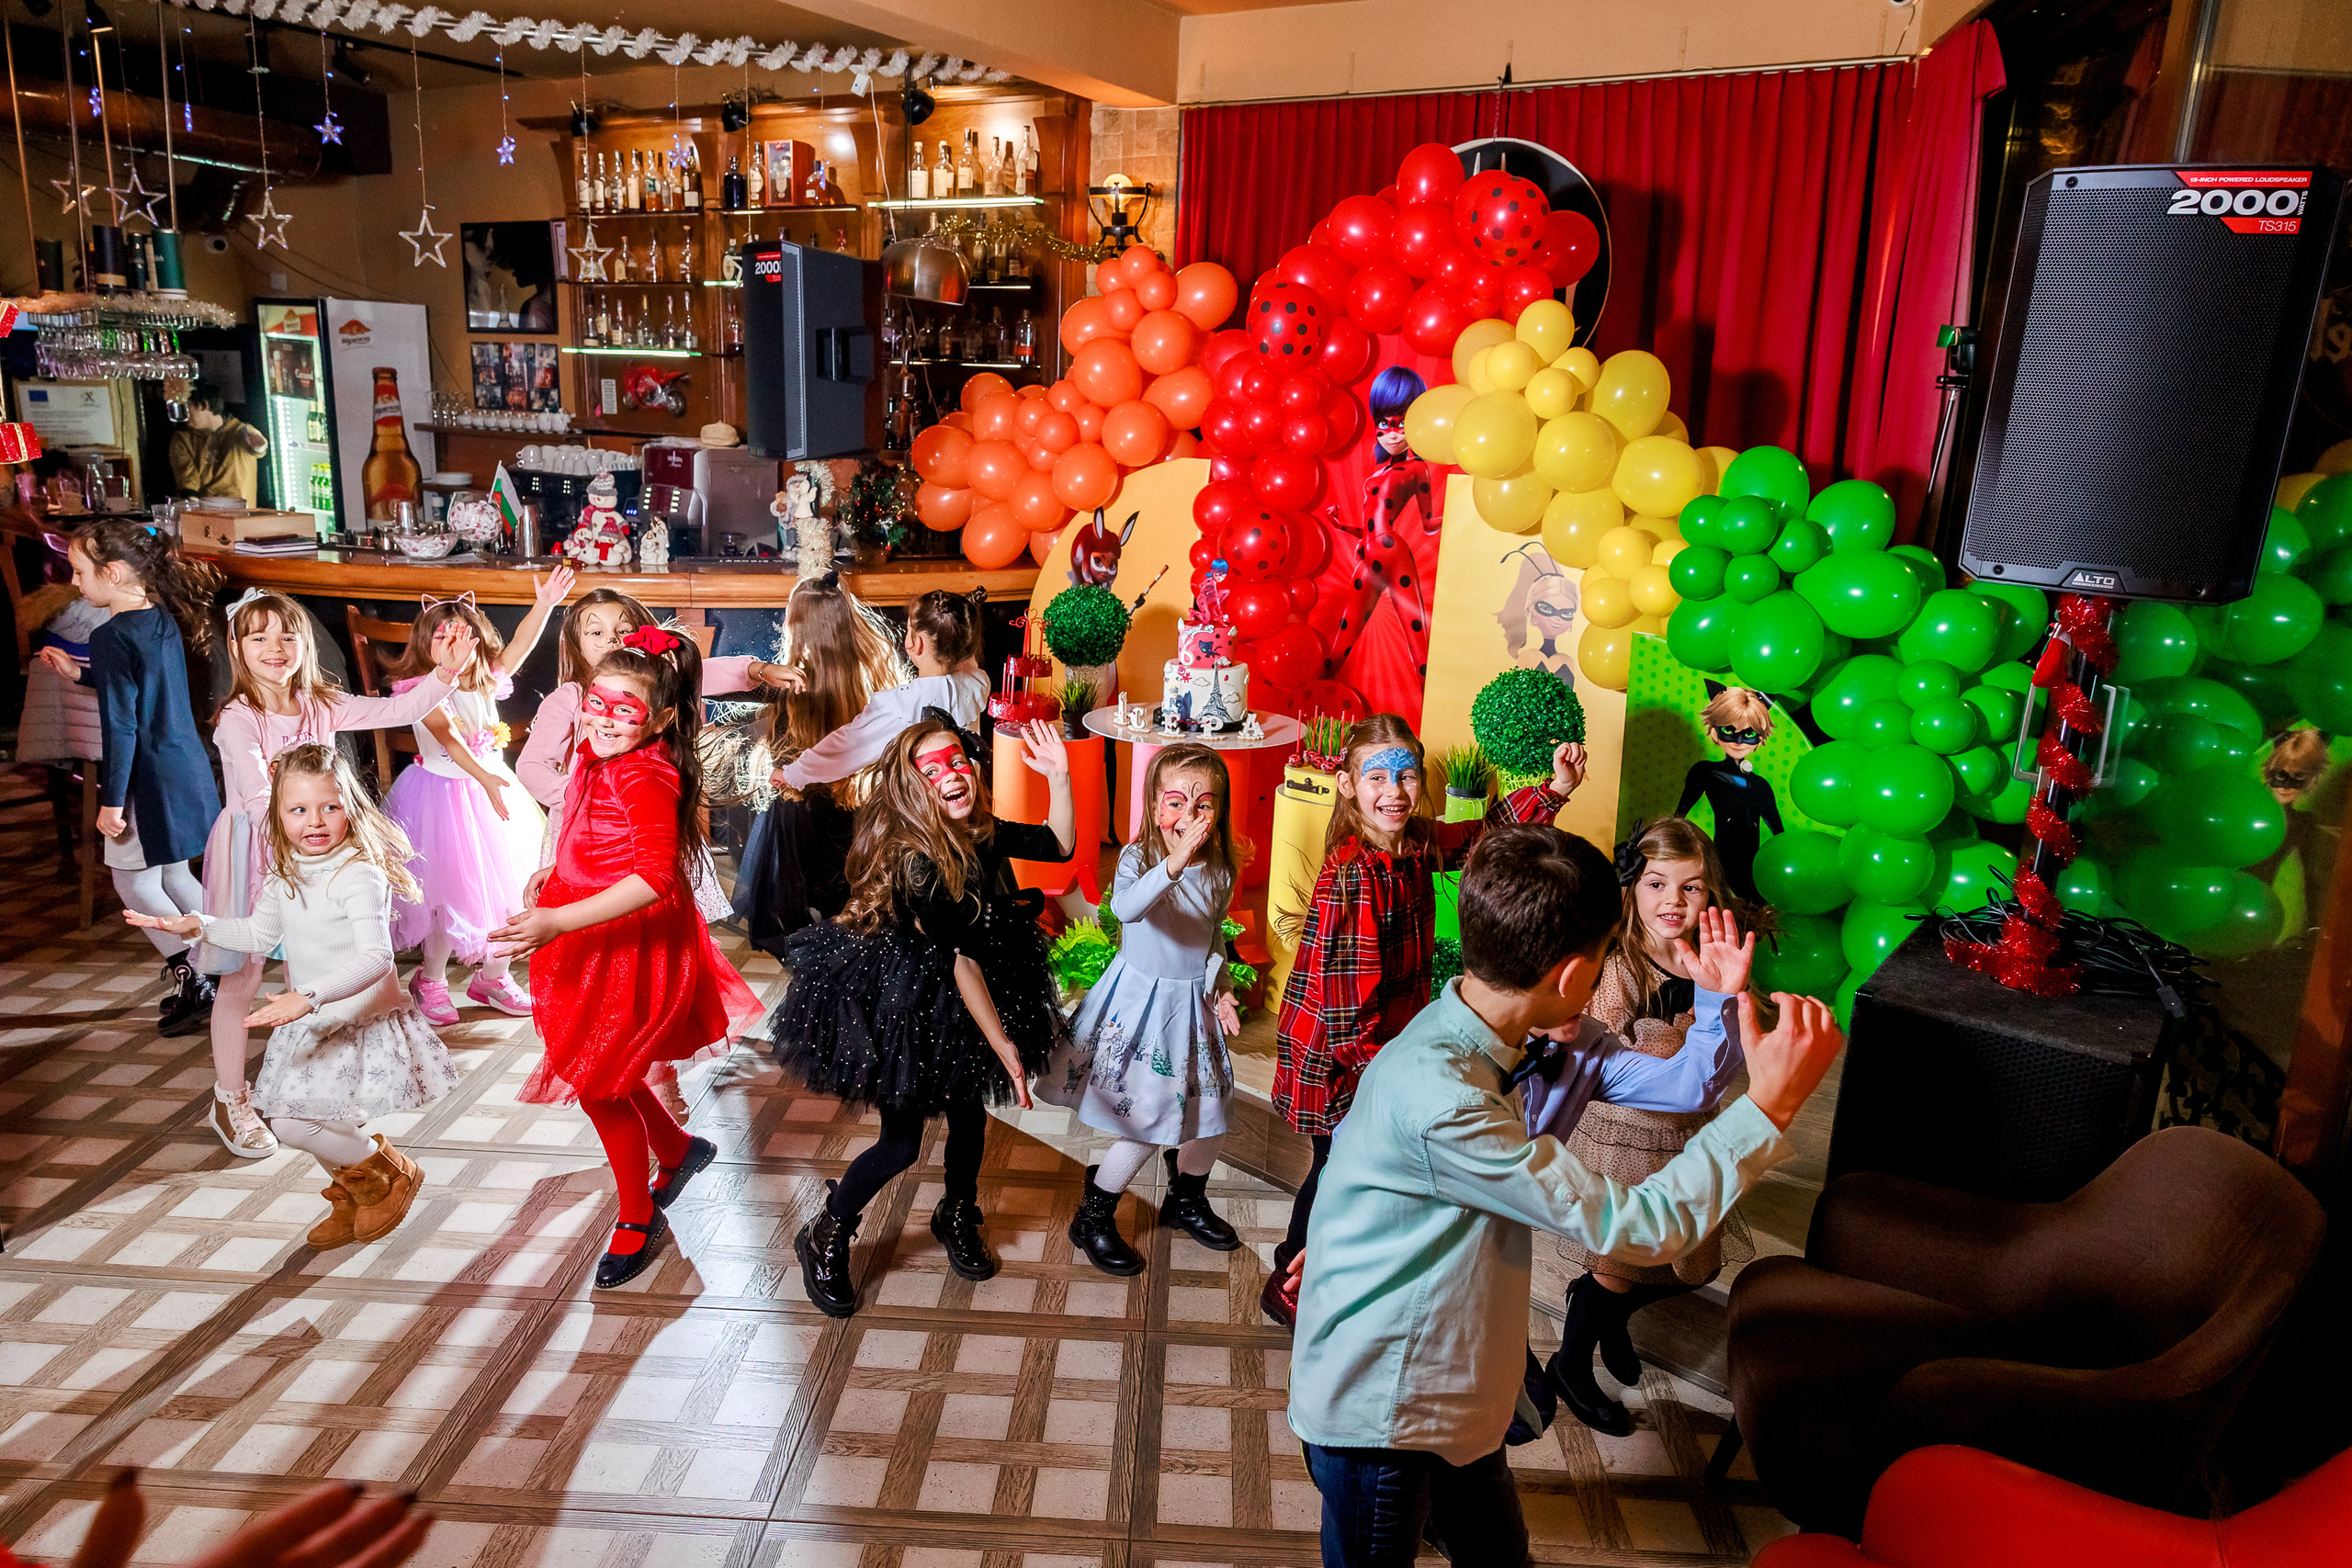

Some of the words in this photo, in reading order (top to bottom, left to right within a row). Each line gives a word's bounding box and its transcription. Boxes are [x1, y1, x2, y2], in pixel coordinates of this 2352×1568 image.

[2166, 188, 2300, 216] 2000
[2297, 190, 2309, 216] WATTS
[2258, 220, 2297, 231] TS315
[754, 260, 780, 275] 2000
[2073, 571, 2115, 585] ALTO
[1181, 638, 1194, 666] 6
